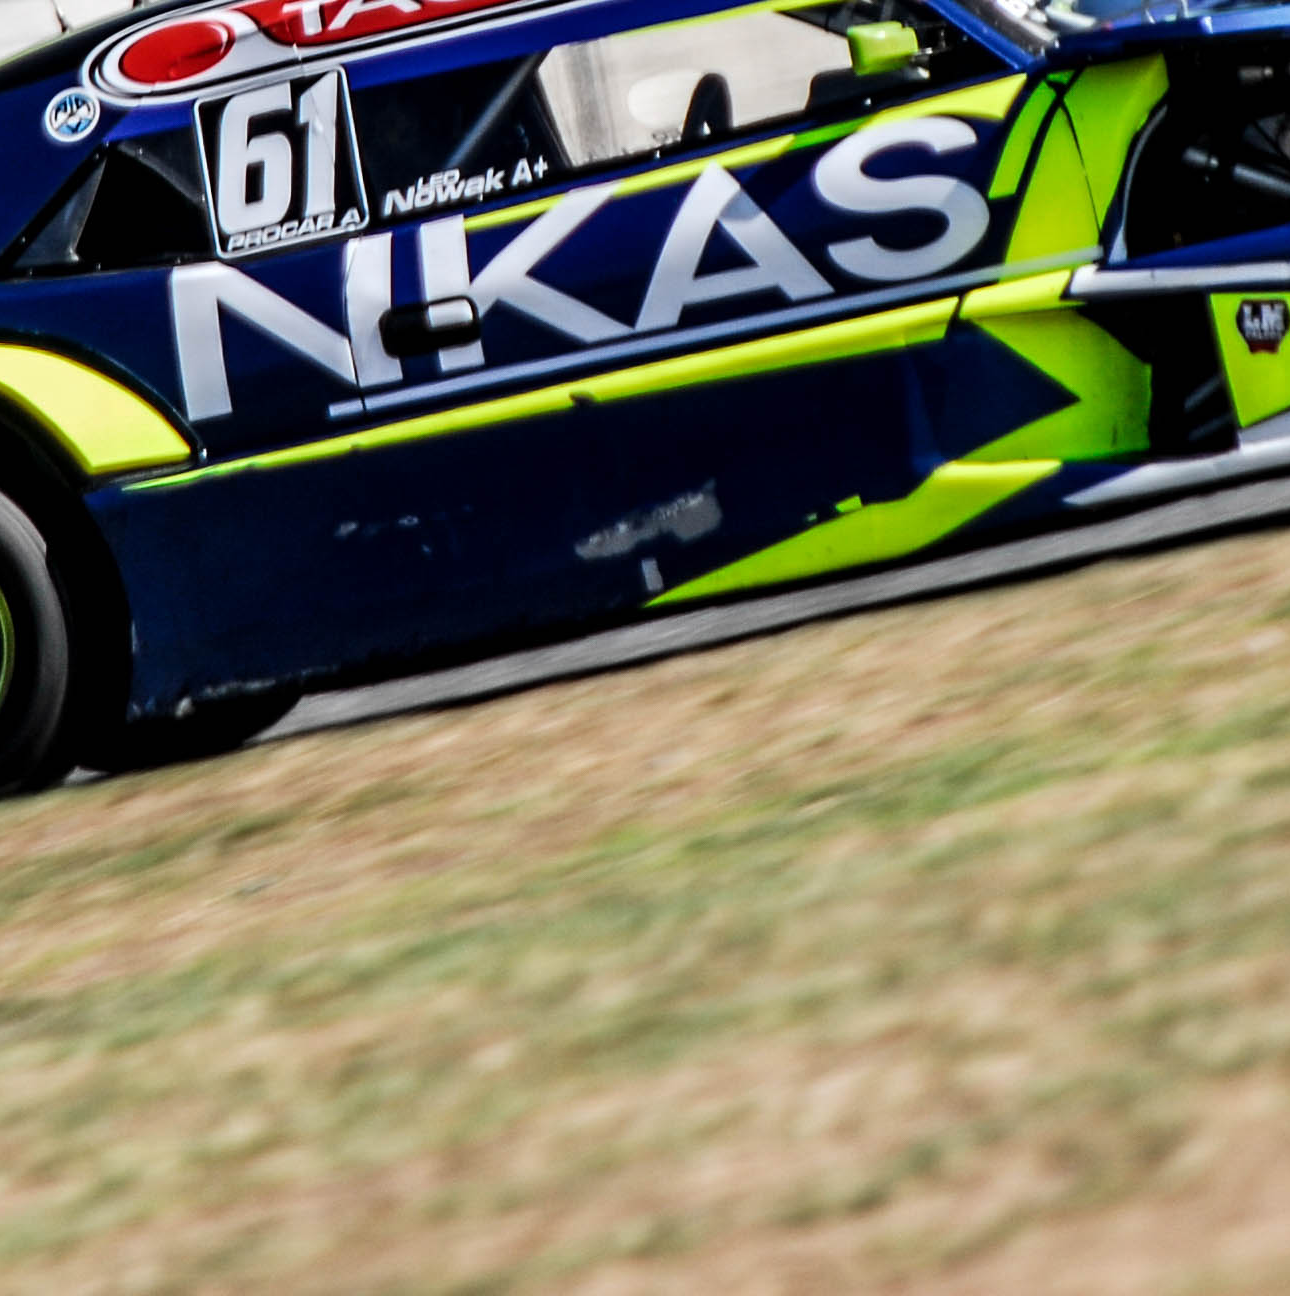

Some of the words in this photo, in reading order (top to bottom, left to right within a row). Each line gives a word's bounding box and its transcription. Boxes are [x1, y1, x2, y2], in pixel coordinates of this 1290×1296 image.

[218, 71, 339, 235] 61
[381, 167, 505, 217] Nowak
[512, 155, 549, 187] A+
[227, 213, 335, 251] PROCAR
[341, 207, 361, 230] A
